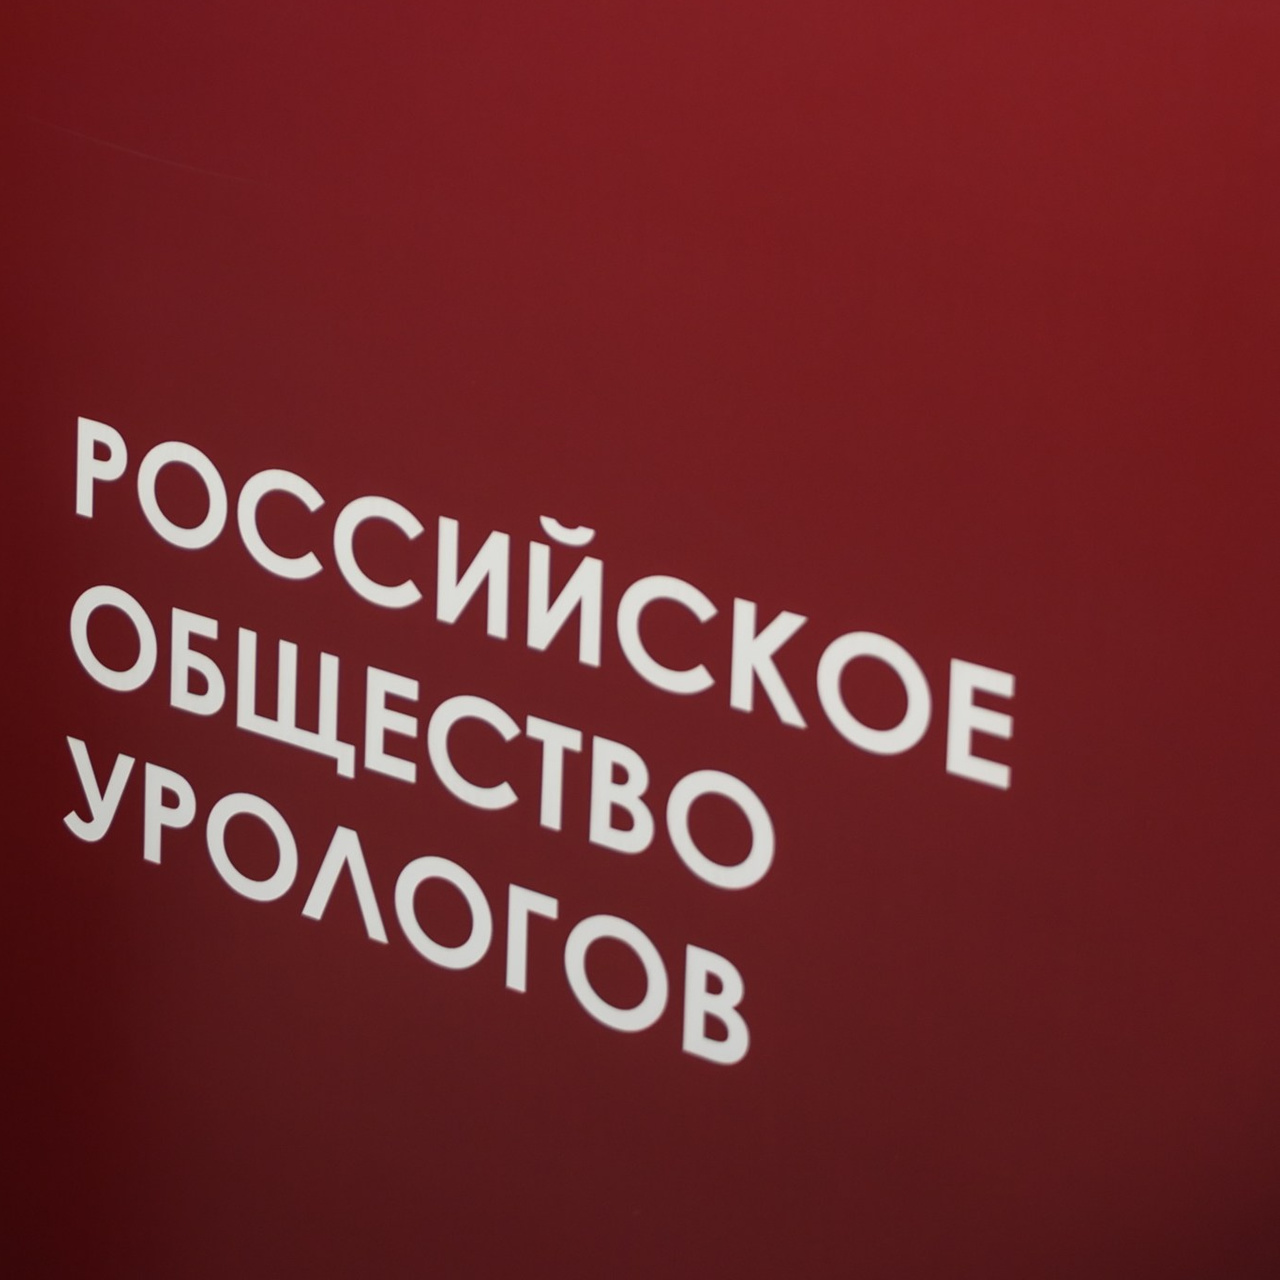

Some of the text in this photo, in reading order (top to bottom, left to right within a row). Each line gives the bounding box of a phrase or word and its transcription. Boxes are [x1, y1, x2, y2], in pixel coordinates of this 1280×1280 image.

[70, 585, 775, 890] ОБЩЕСТВО
[75, 416, 1015, 790] РОССИЙСКОЕ
[63, 735, 750, 1065] УРОЛОГОВ
